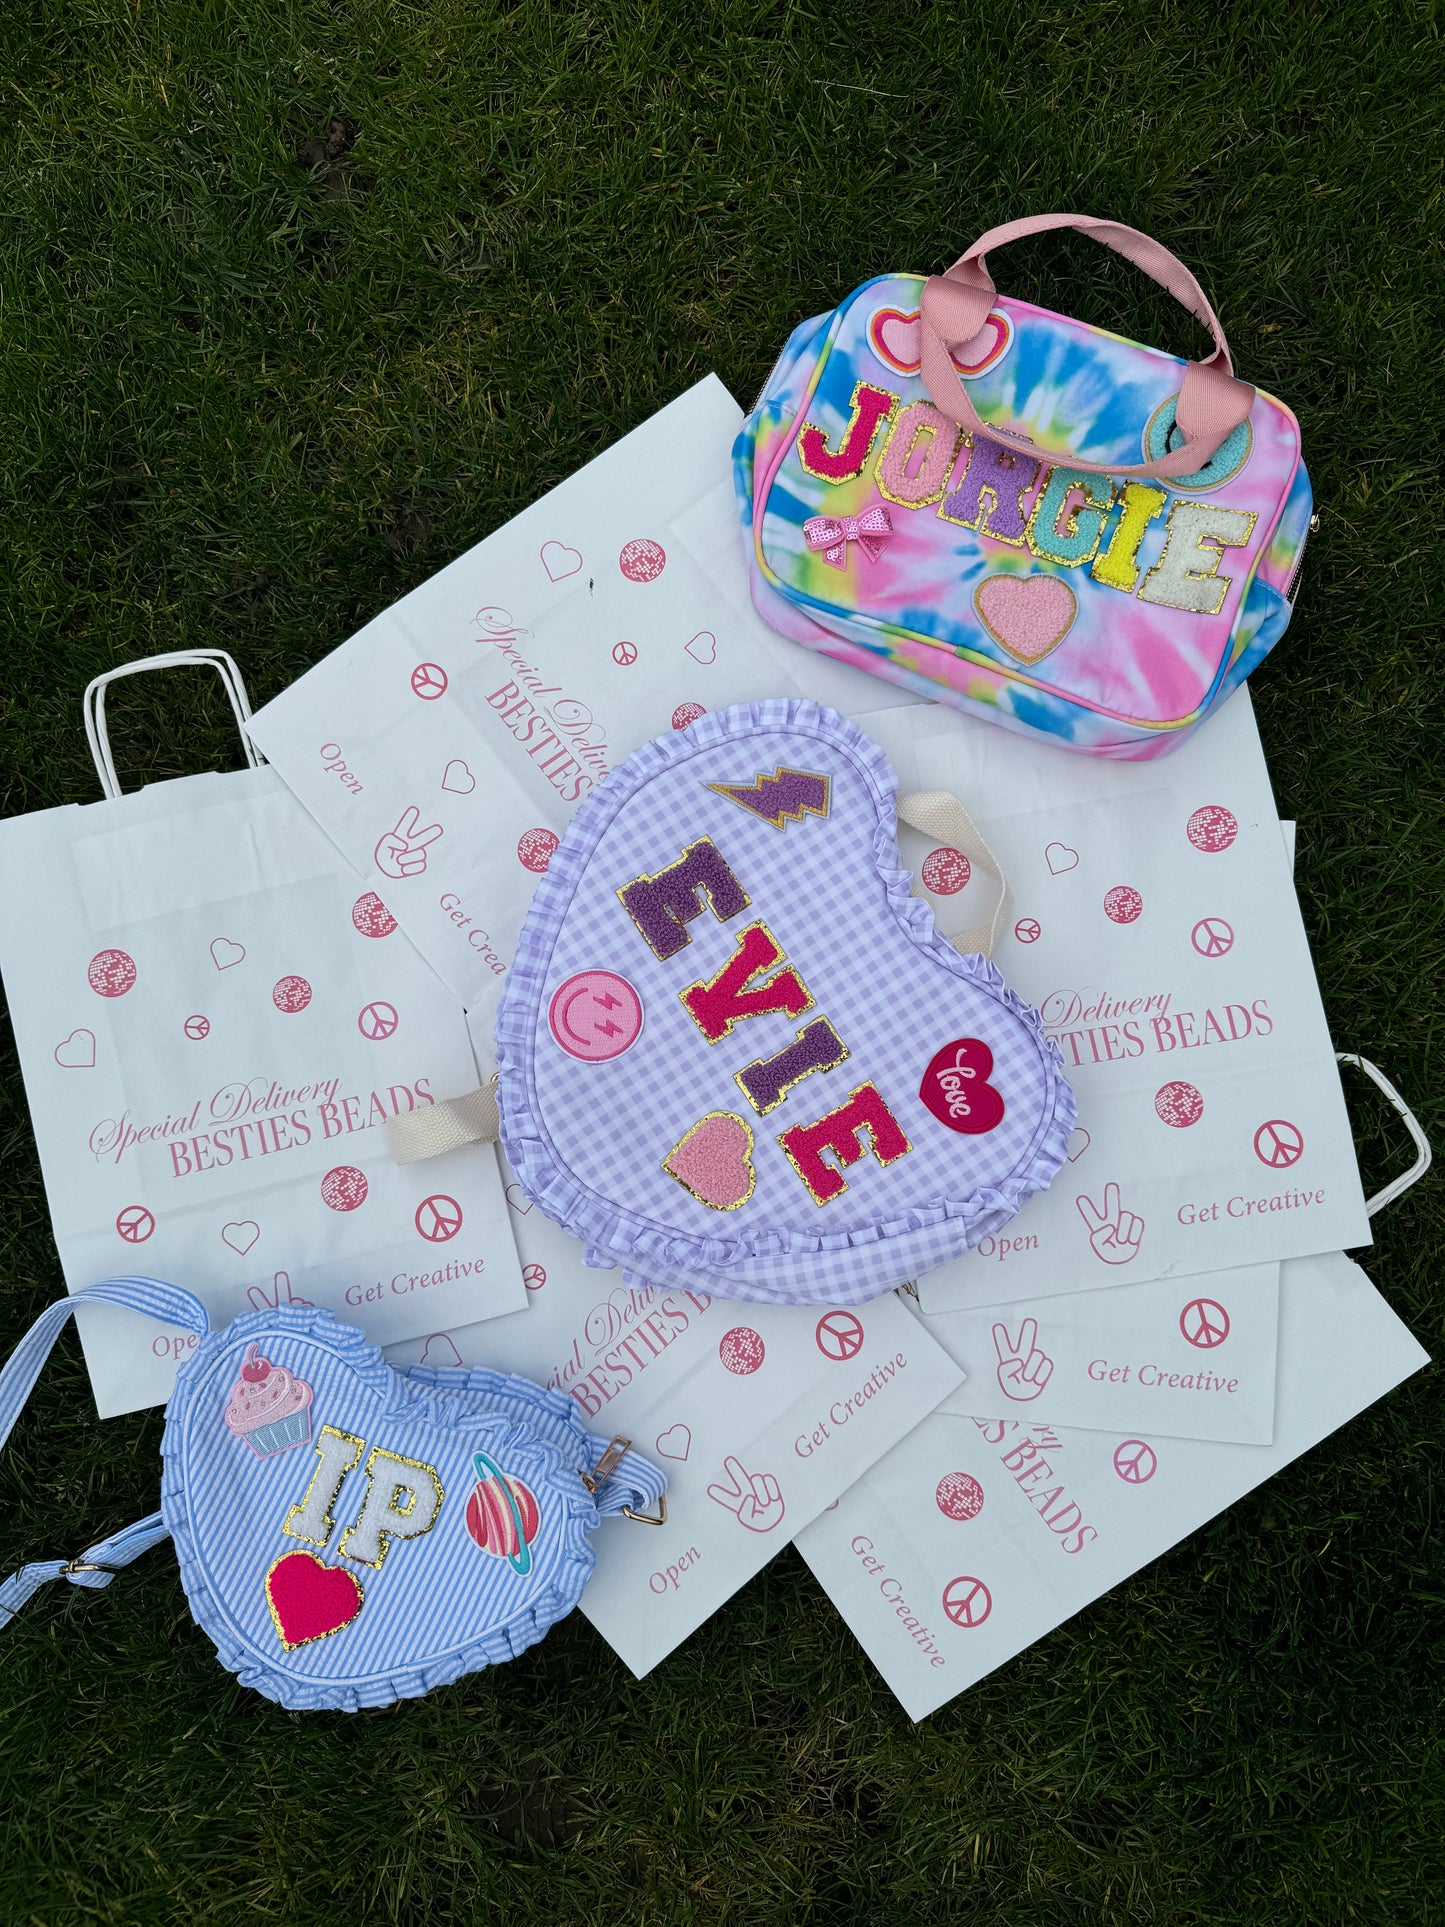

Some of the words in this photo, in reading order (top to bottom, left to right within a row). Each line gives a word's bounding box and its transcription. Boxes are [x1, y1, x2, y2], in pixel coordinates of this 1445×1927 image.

[797, 380, 1259, 616] JORGIE
[469, 606, 563, 698] Special
[543, 698, 611, 782] Delive
[319, 742, 363, 796] Open
[484, 678, 594, 802] BESTIES
[439, 892, 473, 929] Get
[467, 929, 508, 976] Crea
[615, 833, 915, 1209] EVIE
[1045, 1021, 1145, 1068] TIES
[1148, 998, 1274, 1054] BEADS
[89, 1099, 203, 1165] Special
[208, 1076, 344, 1128] Delivery
[935, 1047, 977, 1119] love
[166, 1108, 313, 1179] BESTIES
[316, 1077, 436, 1140] BEADS
[976, 1233, 1040, 1263] Open
[1176, 1200, 1221, 1226] Get
[1226, 1188, 1326, 1219] Creative
[345, 1284, 385, 1306] Get
[390, 1257, 486, 1295] Creative
[584, 1284, 657, 1357] Deliv
[152, 1333, 204, 1361] Ope
[567, 1296, 690, 1419] BESTIES
[1086, 1360, 1130, 1385] Get
[1138, 1363, 1240, 1394] Creative
[794, 1421, 831, 1458] Get
[829, 1352, 907, 1426] Creative
[282, 1424, 446, 1570] IP
[999, 1436, 1099, 1554] BEADS
[648, 1544, 702, 1594] Open
[851, 1535, 886, 1576] Get
[880, 1577, 946, 1668] Creative
